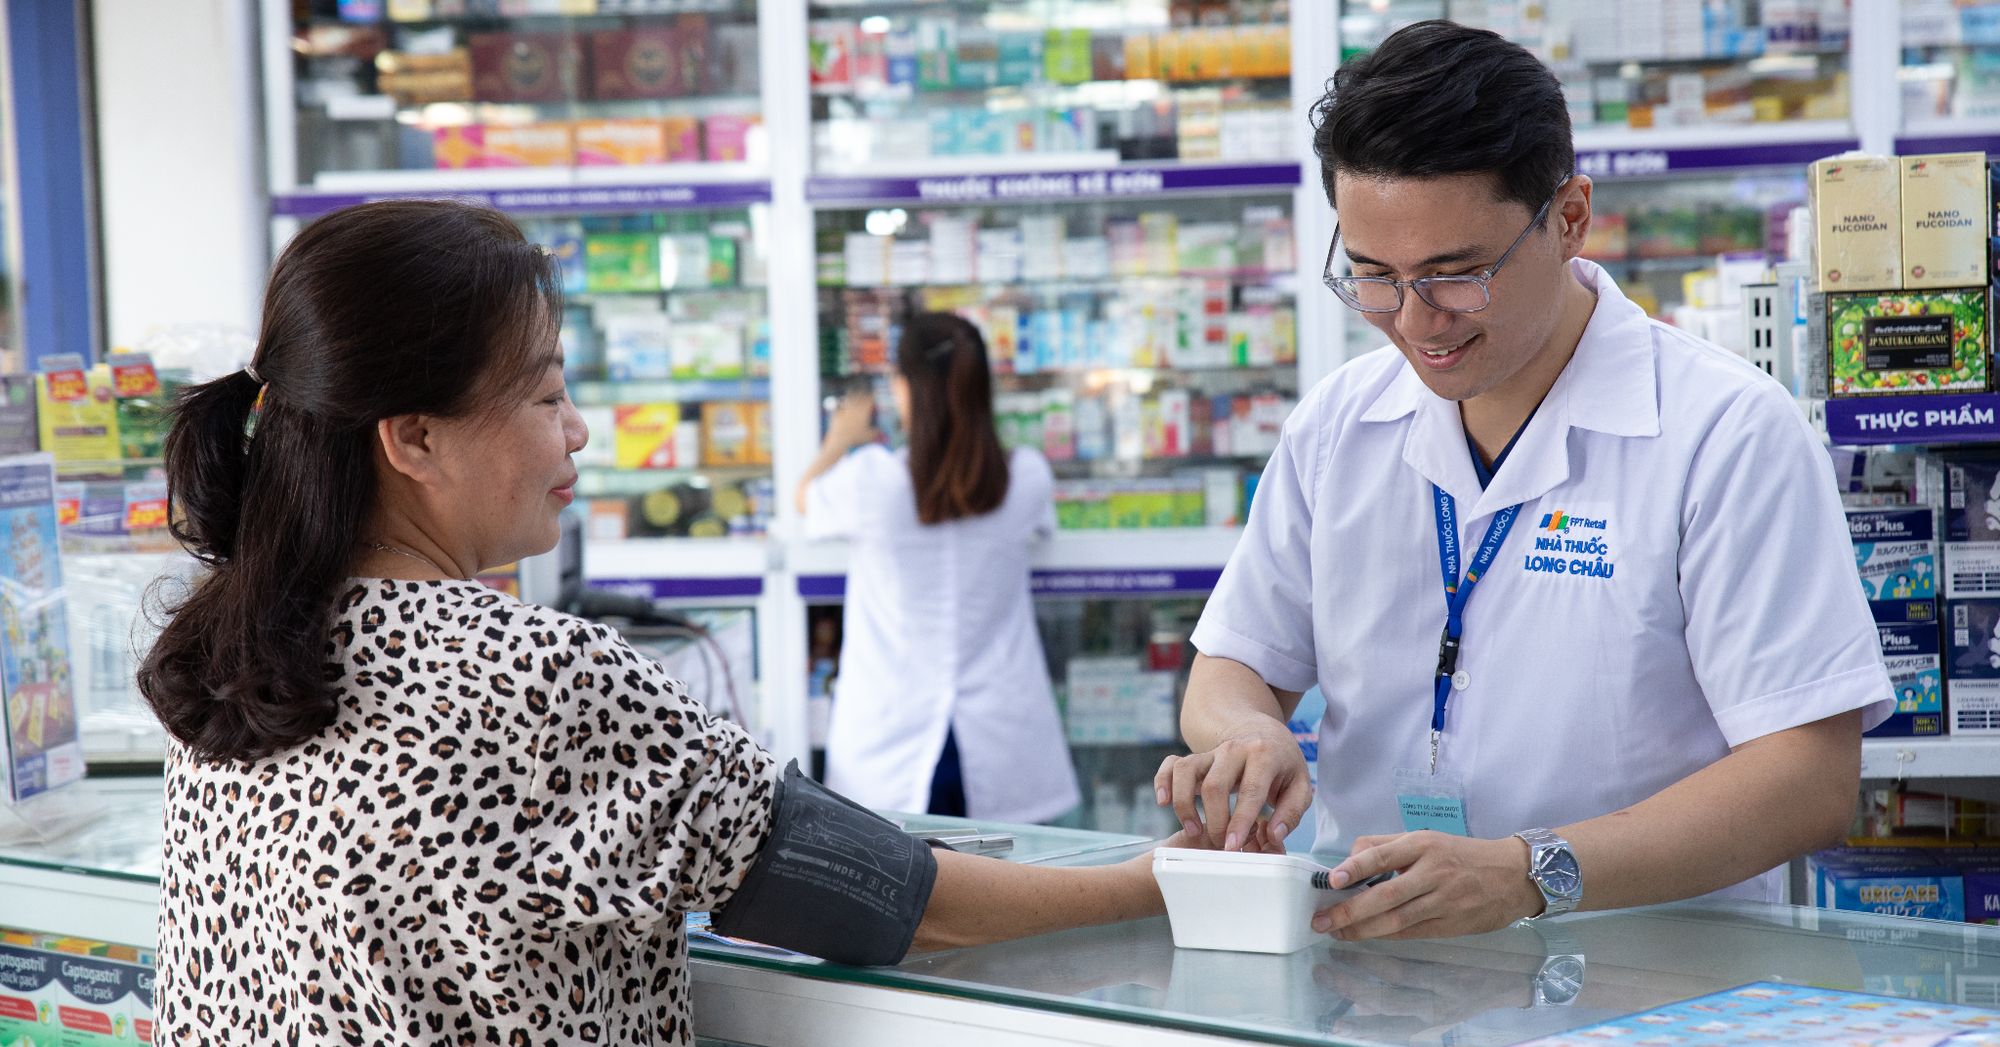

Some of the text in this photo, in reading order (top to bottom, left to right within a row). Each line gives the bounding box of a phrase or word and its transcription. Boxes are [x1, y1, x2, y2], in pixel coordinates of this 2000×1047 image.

[1843, 215, 1875, 223] NANO
[1928, 210, 1960, 219] NANO
[1832, 223, 1888, 233] FUCOIDAN
[1916, 219, 1972, 229] FUCOIDAN
[1868, 333, 1949, 347] JP NATURAL ORGANIC
[1855, 403, 1994, 432] THỰC PHẨM
[1440, 496, 1451, 521] LONG
[1570, 517, 1607, 530] FPT Retail
[1848, 520, 1904, 532] ido Plus
[1441, 523, 1454, 554] THUỐC
[1479, 546, 1494, 564] NHÀ
[1489, 515, 1509, 543] THUỐC
[1535, 534, 1608, 555] NHÀ THUỐC
[1445, 555, 1456, 574] NHÀ
[1524, 555, 1614, 578] LONG CHÂU
[1882, 634, 1911, 646] Plus
[829, 861, 863, 881] INDEX
[1860, 885, 1939, 903] URICARE
[61, 960, 120, 985] Captogastril
[19, 975, 38, 989] pack
[73, 983, 113, 1000] stick pack
